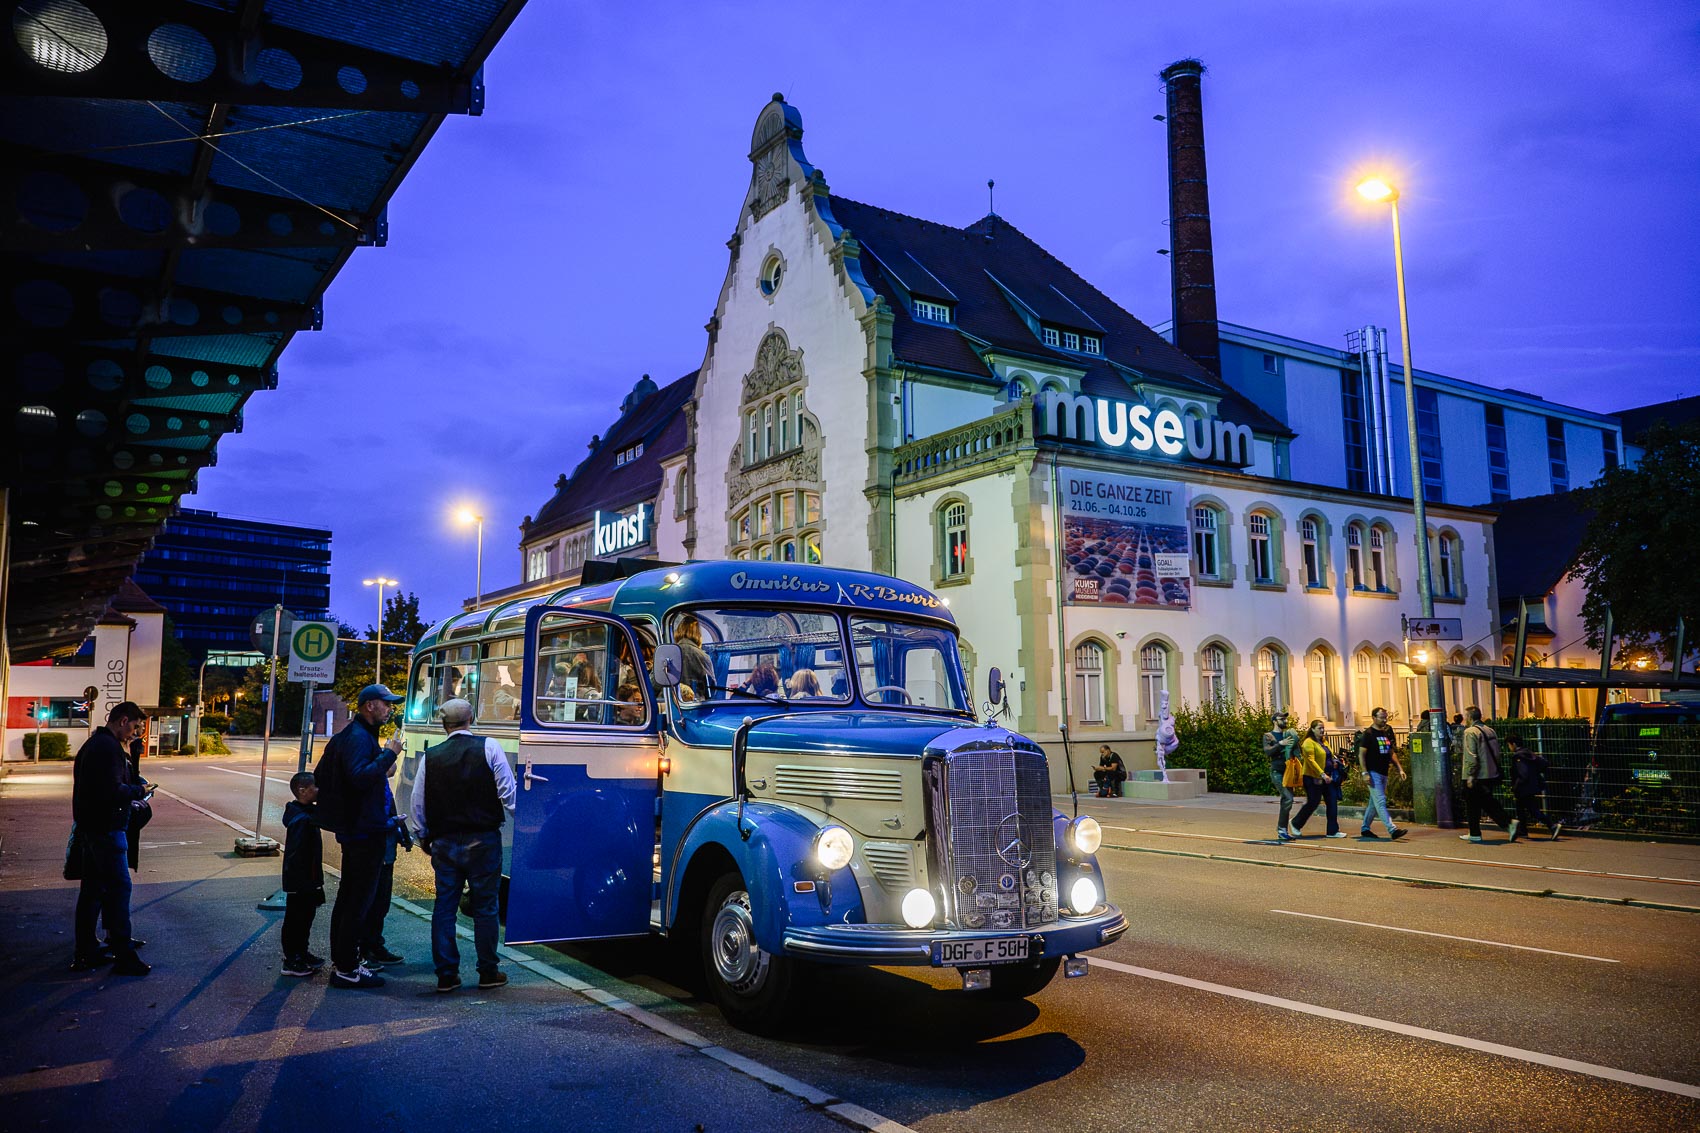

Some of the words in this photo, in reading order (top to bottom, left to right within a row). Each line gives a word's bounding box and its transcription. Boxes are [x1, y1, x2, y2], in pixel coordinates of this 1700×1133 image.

[1046, 390, 1255, 466] museum
[1070, 479, 1094, 497] DIE
[1096, 482, 1143, 503] GANZE
[1145, 488, 1173, 506] ZEIT
[1071, 500, 1100, 513] 21.06.
[1108, 503, 1147, 518] 04.10.26
[594, 503, 645, 556] kunst
[730, 571, 831, 592] Omnibus
[1074, 579, 1099, 589] KUNST
[304, 631, 323, 654] H
[293, 671, 329, 679] haltestelle
[942, 943, 974, 961] DGF
[984, 941, 995, 959] F
[997, 939, 1028, 958] 50H
